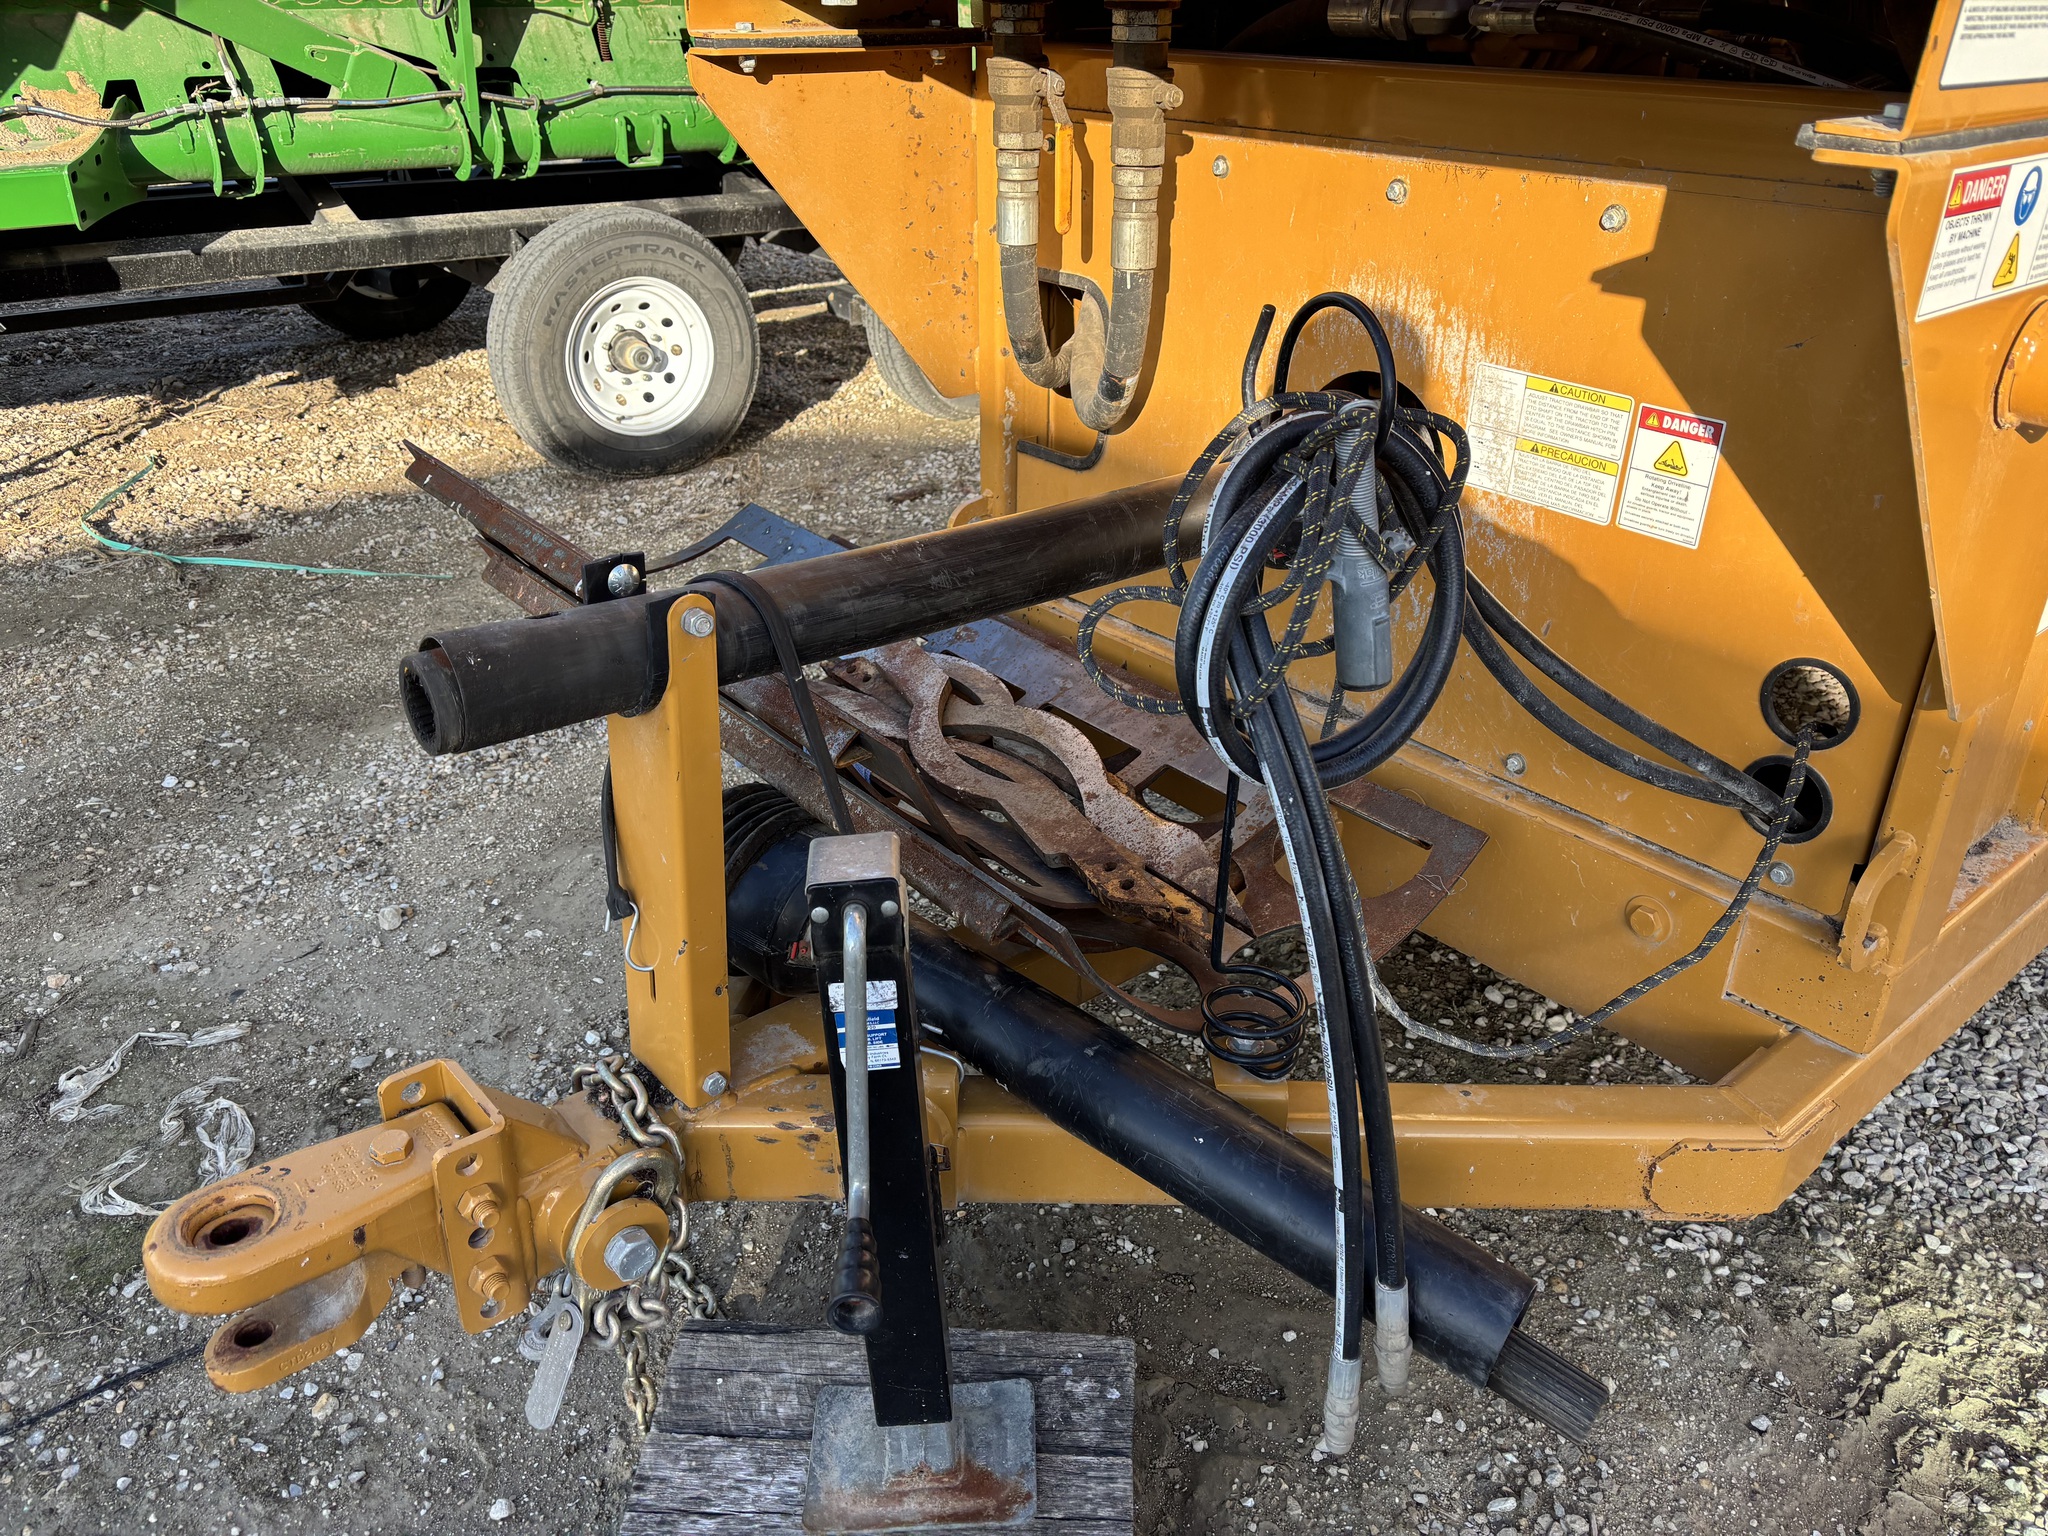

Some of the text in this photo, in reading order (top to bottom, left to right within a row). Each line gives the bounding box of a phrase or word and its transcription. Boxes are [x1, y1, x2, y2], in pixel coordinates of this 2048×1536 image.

[1636, 16, 1715, 46] 21 MPa (3000 PSI)
[1962, 174, 2007, 205] DANGER
[1946, 216, 1970, 230] OBJECTS
[1958, 227, 1982, 241] MACHINE
[542, 243, 706, 327] MASTERTRACK
[1560, 386, 1606, 404] CAUTION
[1662, 416, 1715, 439] DANGER
[1540, 446, 1606, 471] PRECAUCION
[1644, 473, 1691, 490] Rotating Driveline
[1650, 482, 1682, 495] Keep Away!
[1243, 512, 1269, 545] (3000
[1228, 543, 1248, 572] PSI)
[1321, 1040, 1331, 1068] (3000
[1325, 1068, 1334, 1092] PSI)
